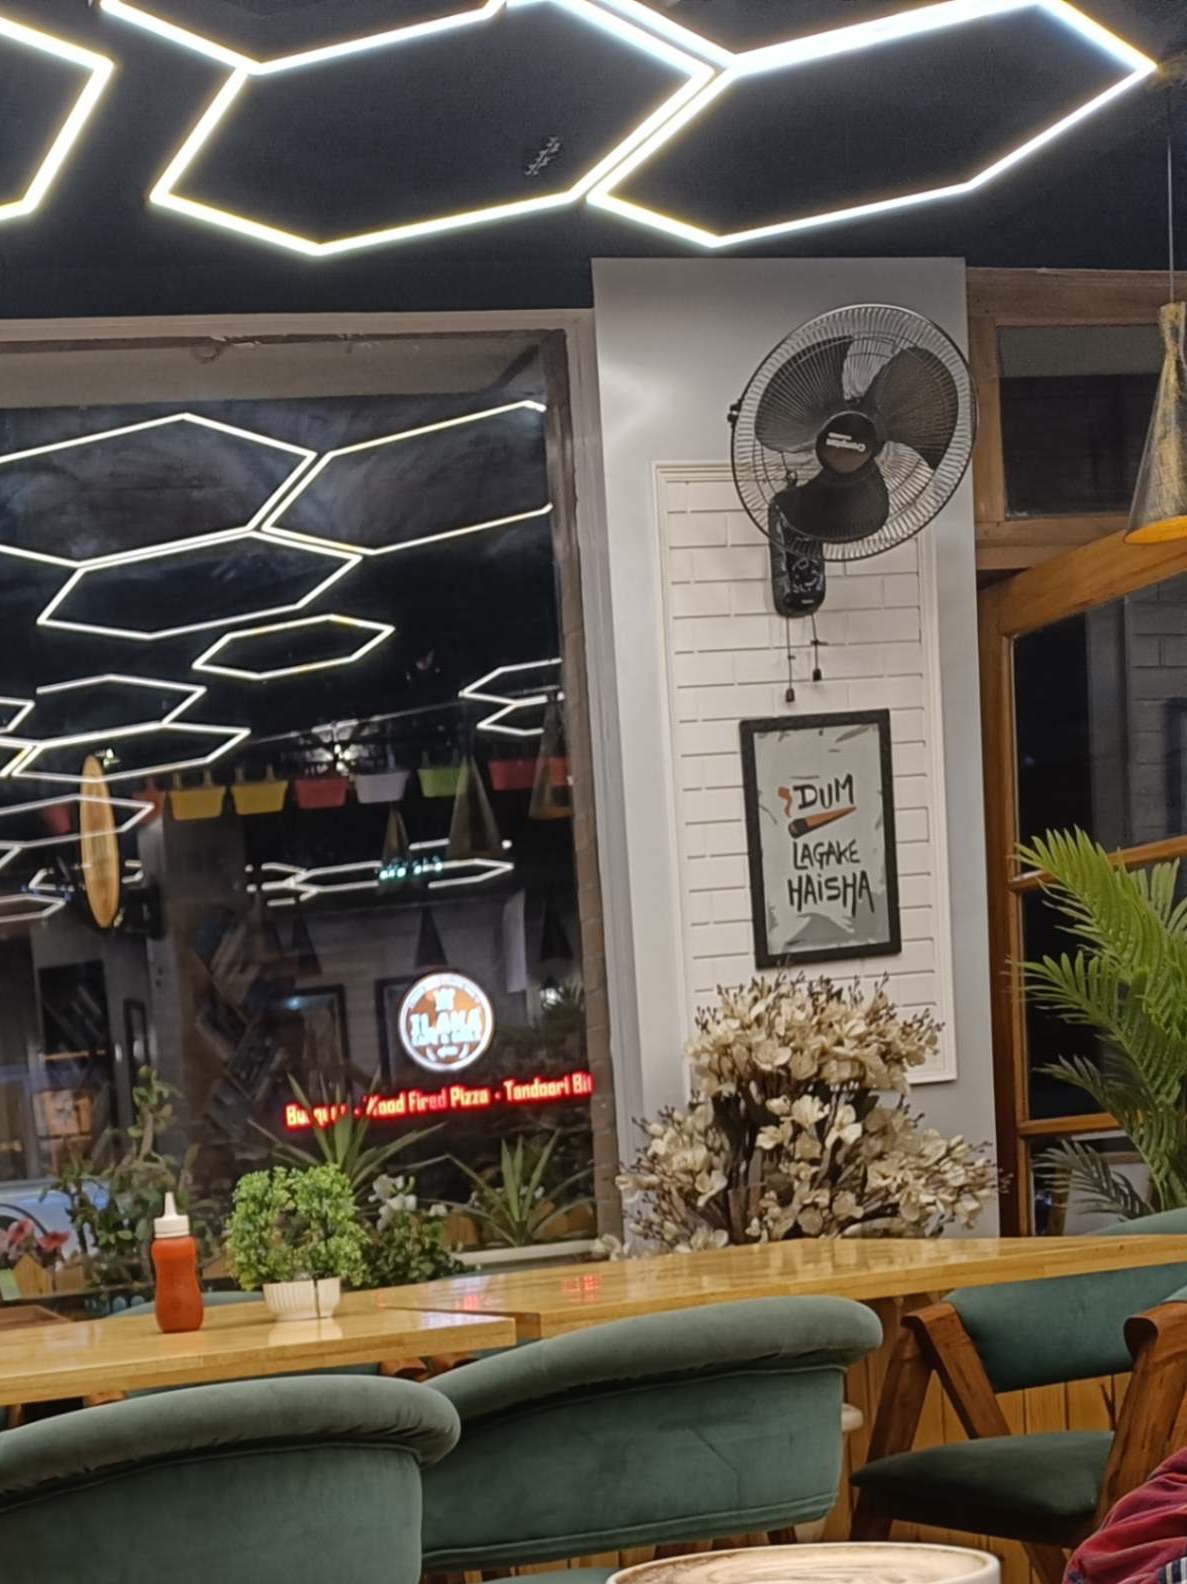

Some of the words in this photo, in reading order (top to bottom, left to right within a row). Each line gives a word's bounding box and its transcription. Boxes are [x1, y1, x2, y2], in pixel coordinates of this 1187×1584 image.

[792, 773, 854, 811] DUM
[792, 838, 861, 871] LAGAKE
[408, 1088, 448, 1111] Fired
[450, 1086, 490, 1109] Pizza
[503, 1075, 570, 1101] Tandoori
